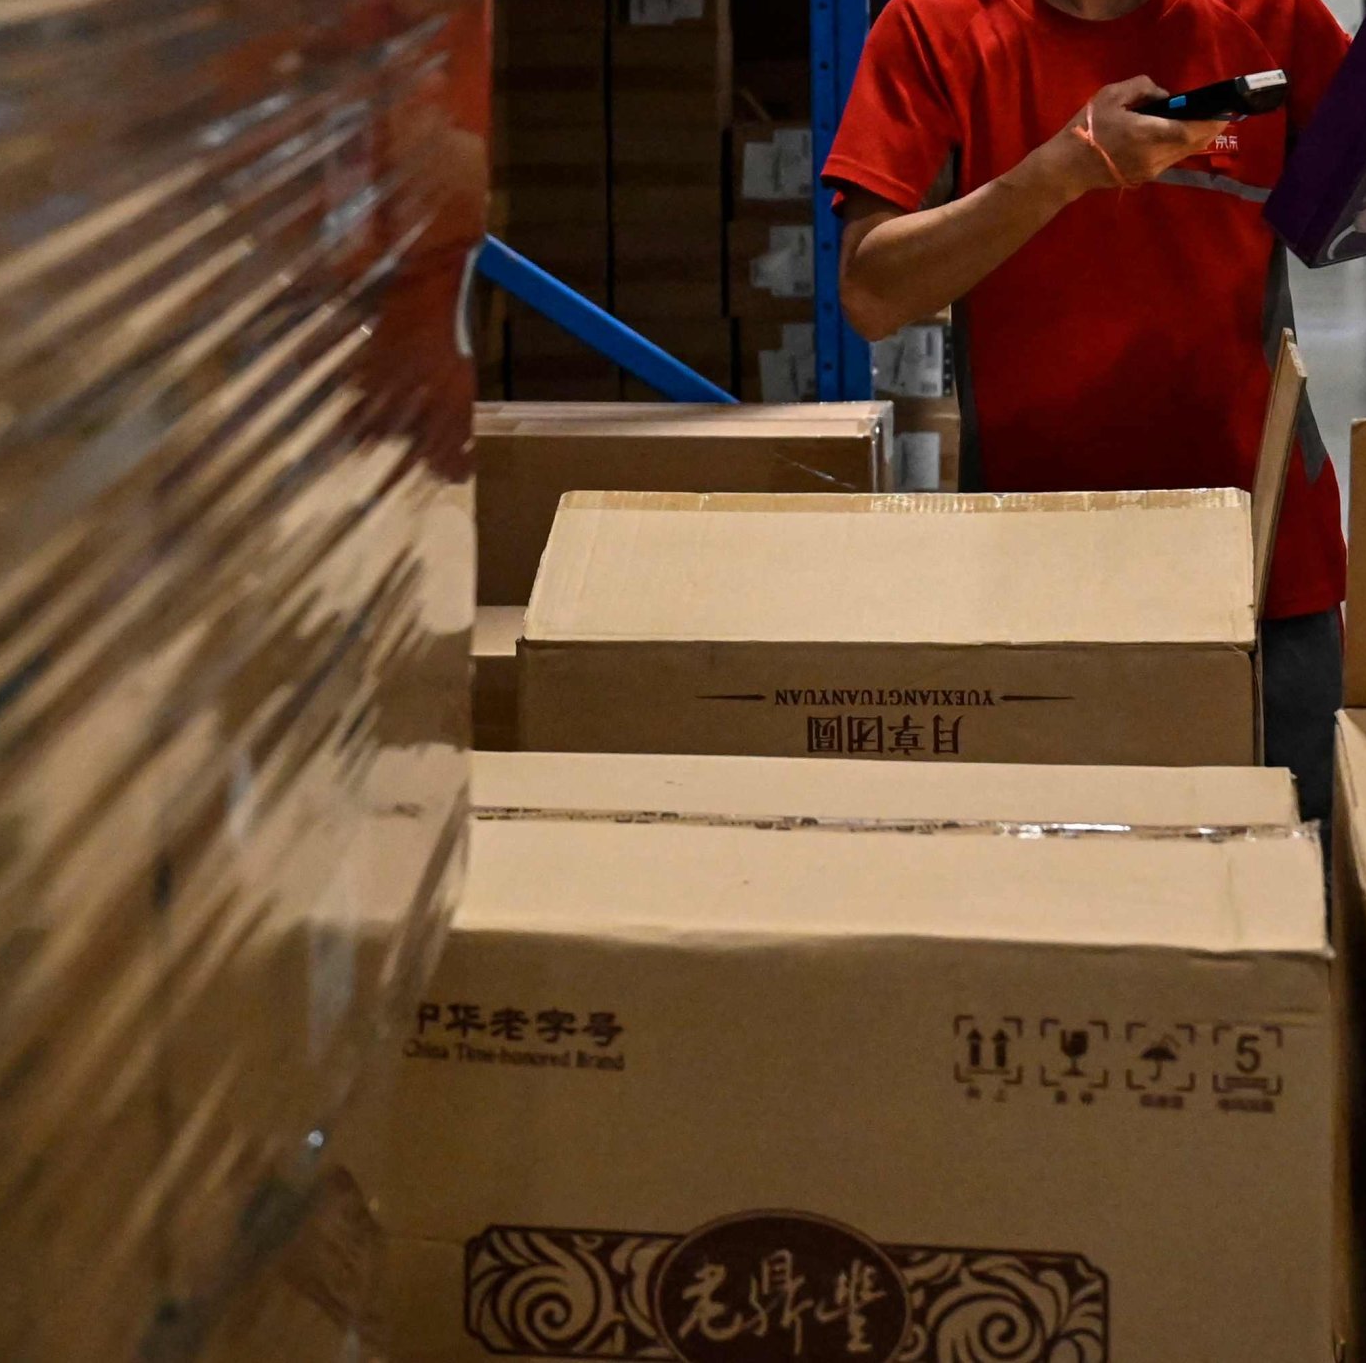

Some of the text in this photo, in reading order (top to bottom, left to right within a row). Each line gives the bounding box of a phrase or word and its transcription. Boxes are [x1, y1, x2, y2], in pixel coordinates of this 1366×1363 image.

[774, 689, 996, 707] YUEXIANGTUANYUAN
[806, 713, 964, 755] 月享团圆
[1235, 1034, 1262, 1074] 5
